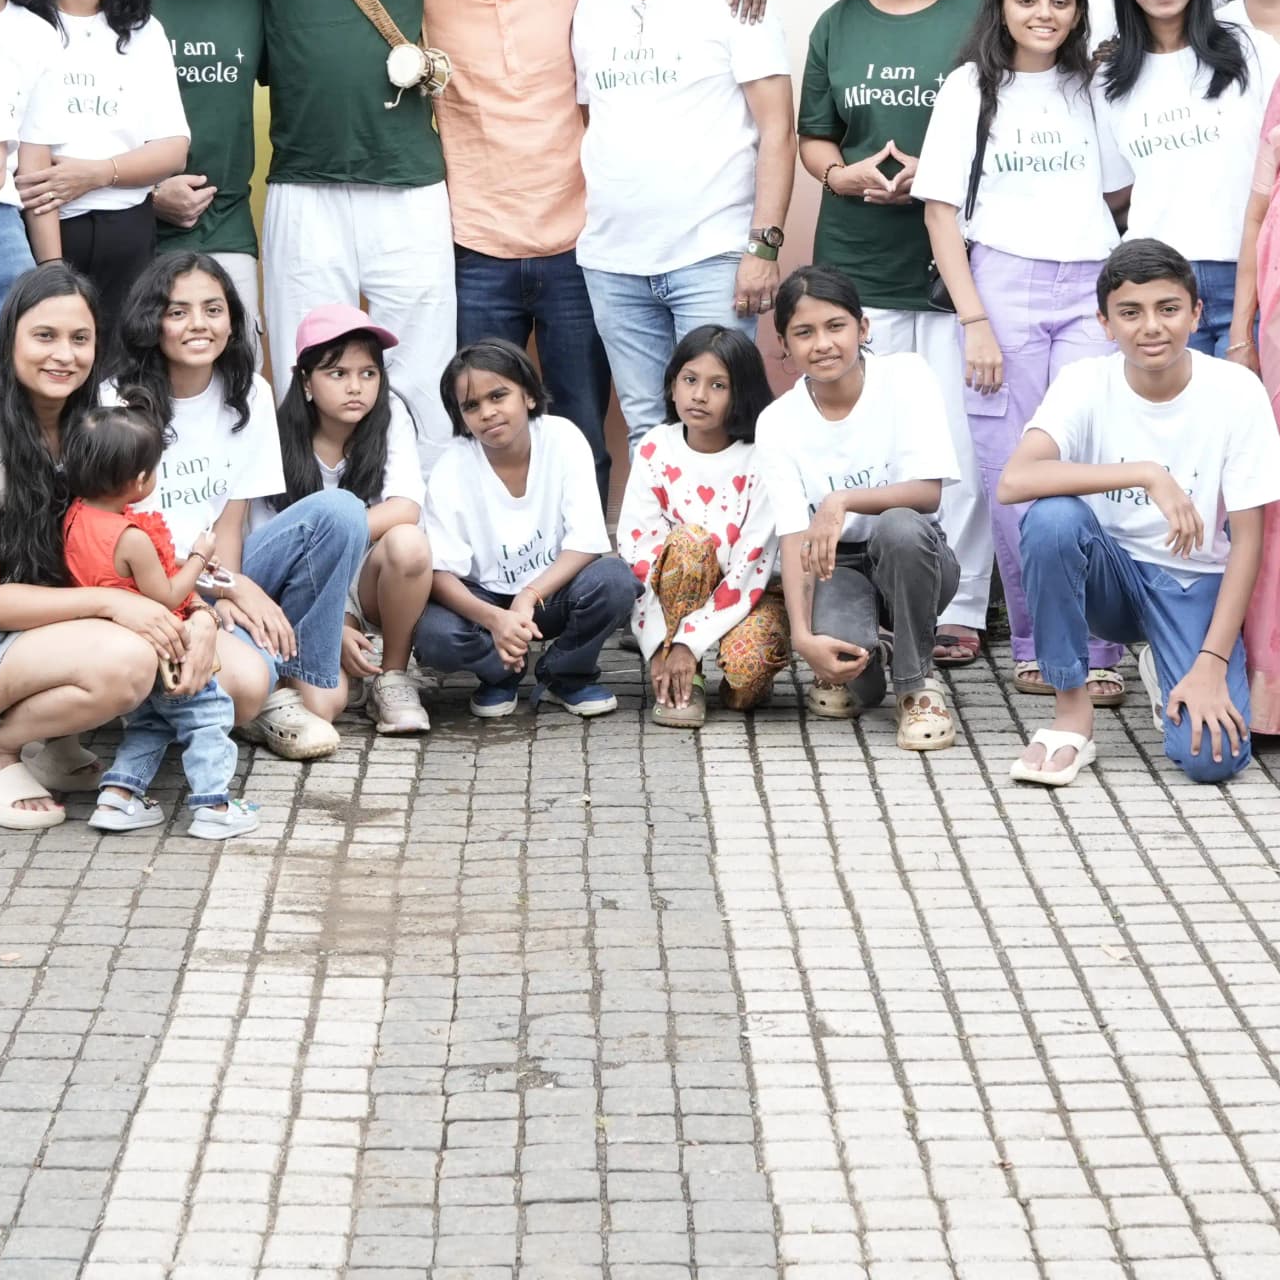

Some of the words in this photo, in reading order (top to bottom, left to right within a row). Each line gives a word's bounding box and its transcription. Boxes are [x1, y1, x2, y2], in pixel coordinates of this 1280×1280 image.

[184, 41, 216, 56] am
[624, 47, 654, 61] am
[175, 62, 238, 83] racle
[866, 64, 874, 79] I
[880, 66, 915, 79] am
[67, 96, 118, 116] acle
[845, 83, 937, 109] Miracle
[1030, 129, 1061, 144] am
[994, 151, 1085, 173] Miracle
[176, 456, 210, 476] am
